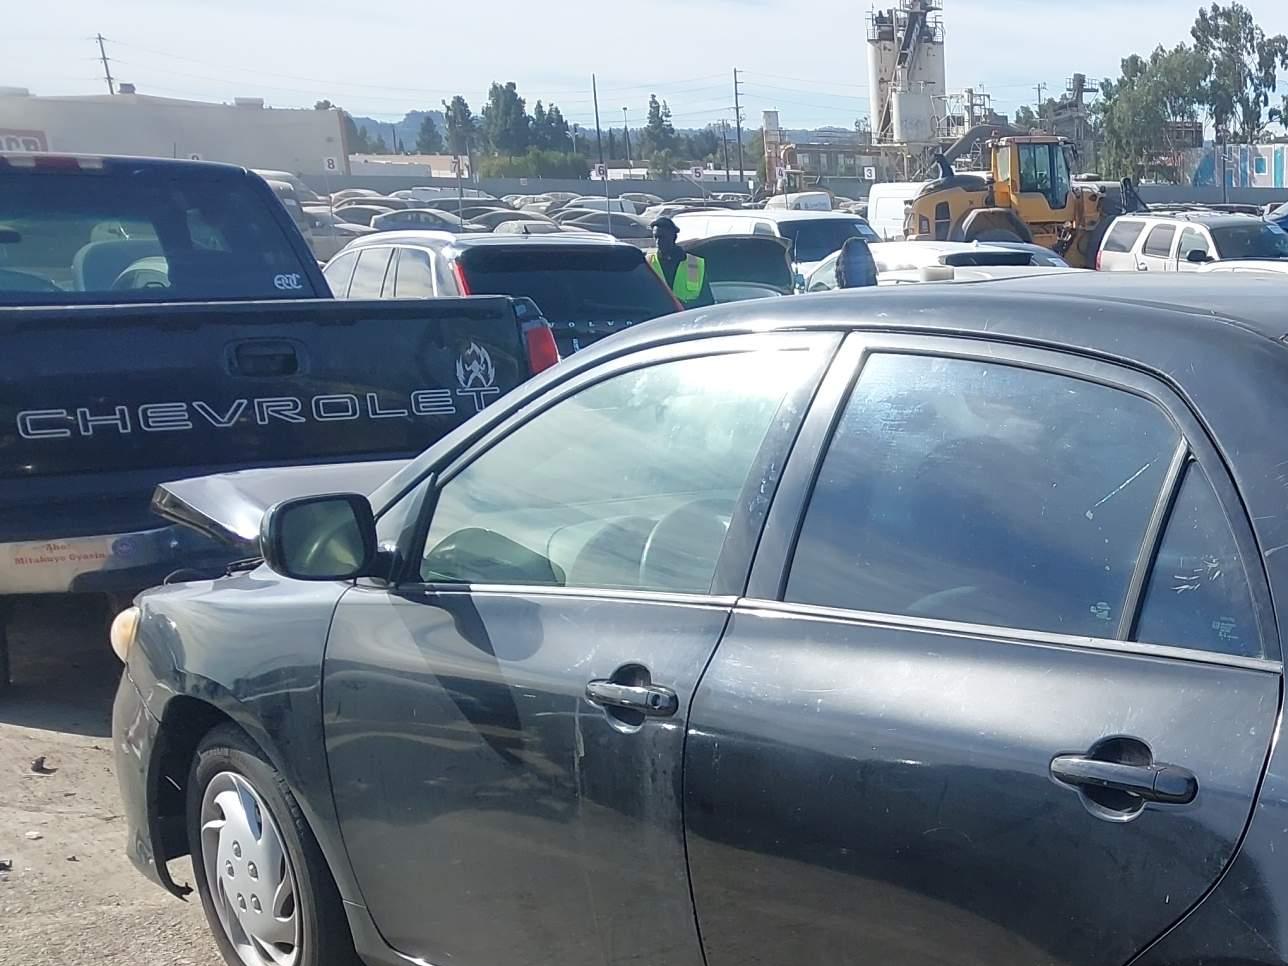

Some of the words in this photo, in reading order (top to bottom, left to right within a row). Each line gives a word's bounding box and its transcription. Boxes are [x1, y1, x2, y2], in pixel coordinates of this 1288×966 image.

[327, 158, 335, 170] 8
[598, 165, 605, 176] 6
[695, 168, 702, 178] 5
[866, 168, 873, 178] 3
[16, 386, 500, 440] CHEVROLET
